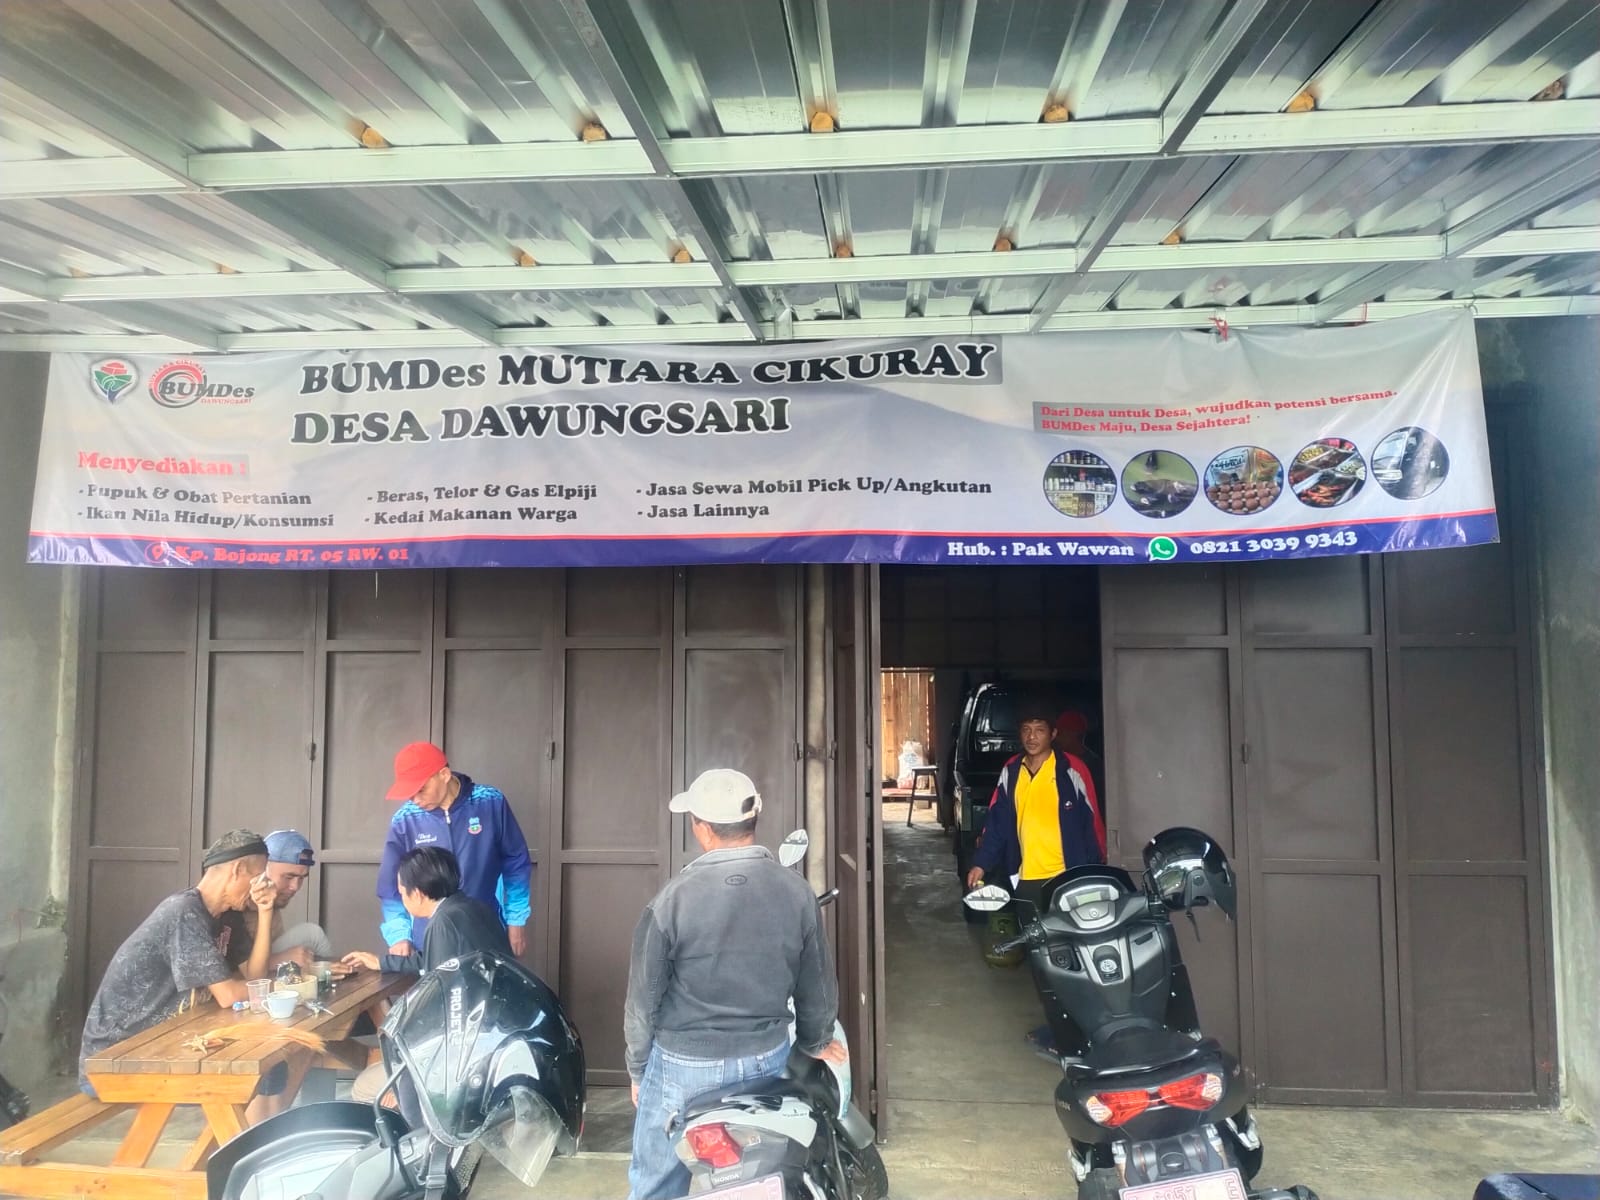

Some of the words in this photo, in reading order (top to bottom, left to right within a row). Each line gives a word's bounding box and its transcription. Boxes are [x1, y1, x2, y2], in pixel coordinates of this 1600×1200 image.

[299, 359, 487, 394] BUMDes
[499, 354, 741, 386] MUTIARA
[753, 344, 996, 383] CIKURAY
[158, 381, 256, 398] BUMDes
[1040, 406, 1070, 418] Dari
[1073, 408, 1105, 418] Desa
[1109, 409, 1151, 419] untuk
[1155, 407, 1192, 419] Desa,
[1195, 399, 1271, 414] wujudkan
[1275, 397, 1327, 410] potensi
[1329, 389, 1398, 405] bersama.
[291, 410, 430, 444] DESA
[441, 399, 790, 440] DAWUNGSARI
[1041, 420, 1096, 432] BUMDes
[1099, 422, 1137, 434] Maju,
[1140, 422, 1172, 433] Desa
[1176, 415, 1251, 432] Sejahtera!
[78, 451, 233, 475] Menyediakan
[87, 484, 148, 500] Pupuk
[152, 487, 170, 499] &
[173, 489, 218, 504] Obat
[221, 491, 312, 505] Pertanian
[376, 490, 429, 503] Beras,
[433, 486, 479, 500] Telor
[483, 484, 501, 497] &
[505, 485, 539, 498] Gas
[544, 484, 597, 500] Elpiji
[645, 483, 687, 496] Jasa
[692, 482, 743, 495] Sewa
[748, 479, 803, 494] Mobil
[807, 478, 852, 492] Pick
[856, 476, 992, 496] Up/Angkutan
[86, 506, 127, 520] Ikan
[131, 508, 170, 522] Nila
[174, 510, 334, 529] Hidup/Konsumsi
[373, 511, 424, 525] Kedai
[428, 508, 512, 523] Makanan
[517, 507, 578, 523] Warga
[647, 505, 688, 518] Jasa
[693, 503, 770, 519] Lainnya
[947, 542, 996, 556] Hub.
[1011, 542, 1053, 556] Pak
[1056, 542, 1135, 557] Wawan
[1190, 540, 1242, 555] 0821
[1246, 536, 1300, 552] 3039
[1304, 531, 1358, 549] 9343
[213, 547, 282, 565] Bojong
[285, 548, 316, 562] RT.
[320, 550, 344, 563] 05
[347, 547, 383, 561] RW.
[388, 548, 409, 561] 01
